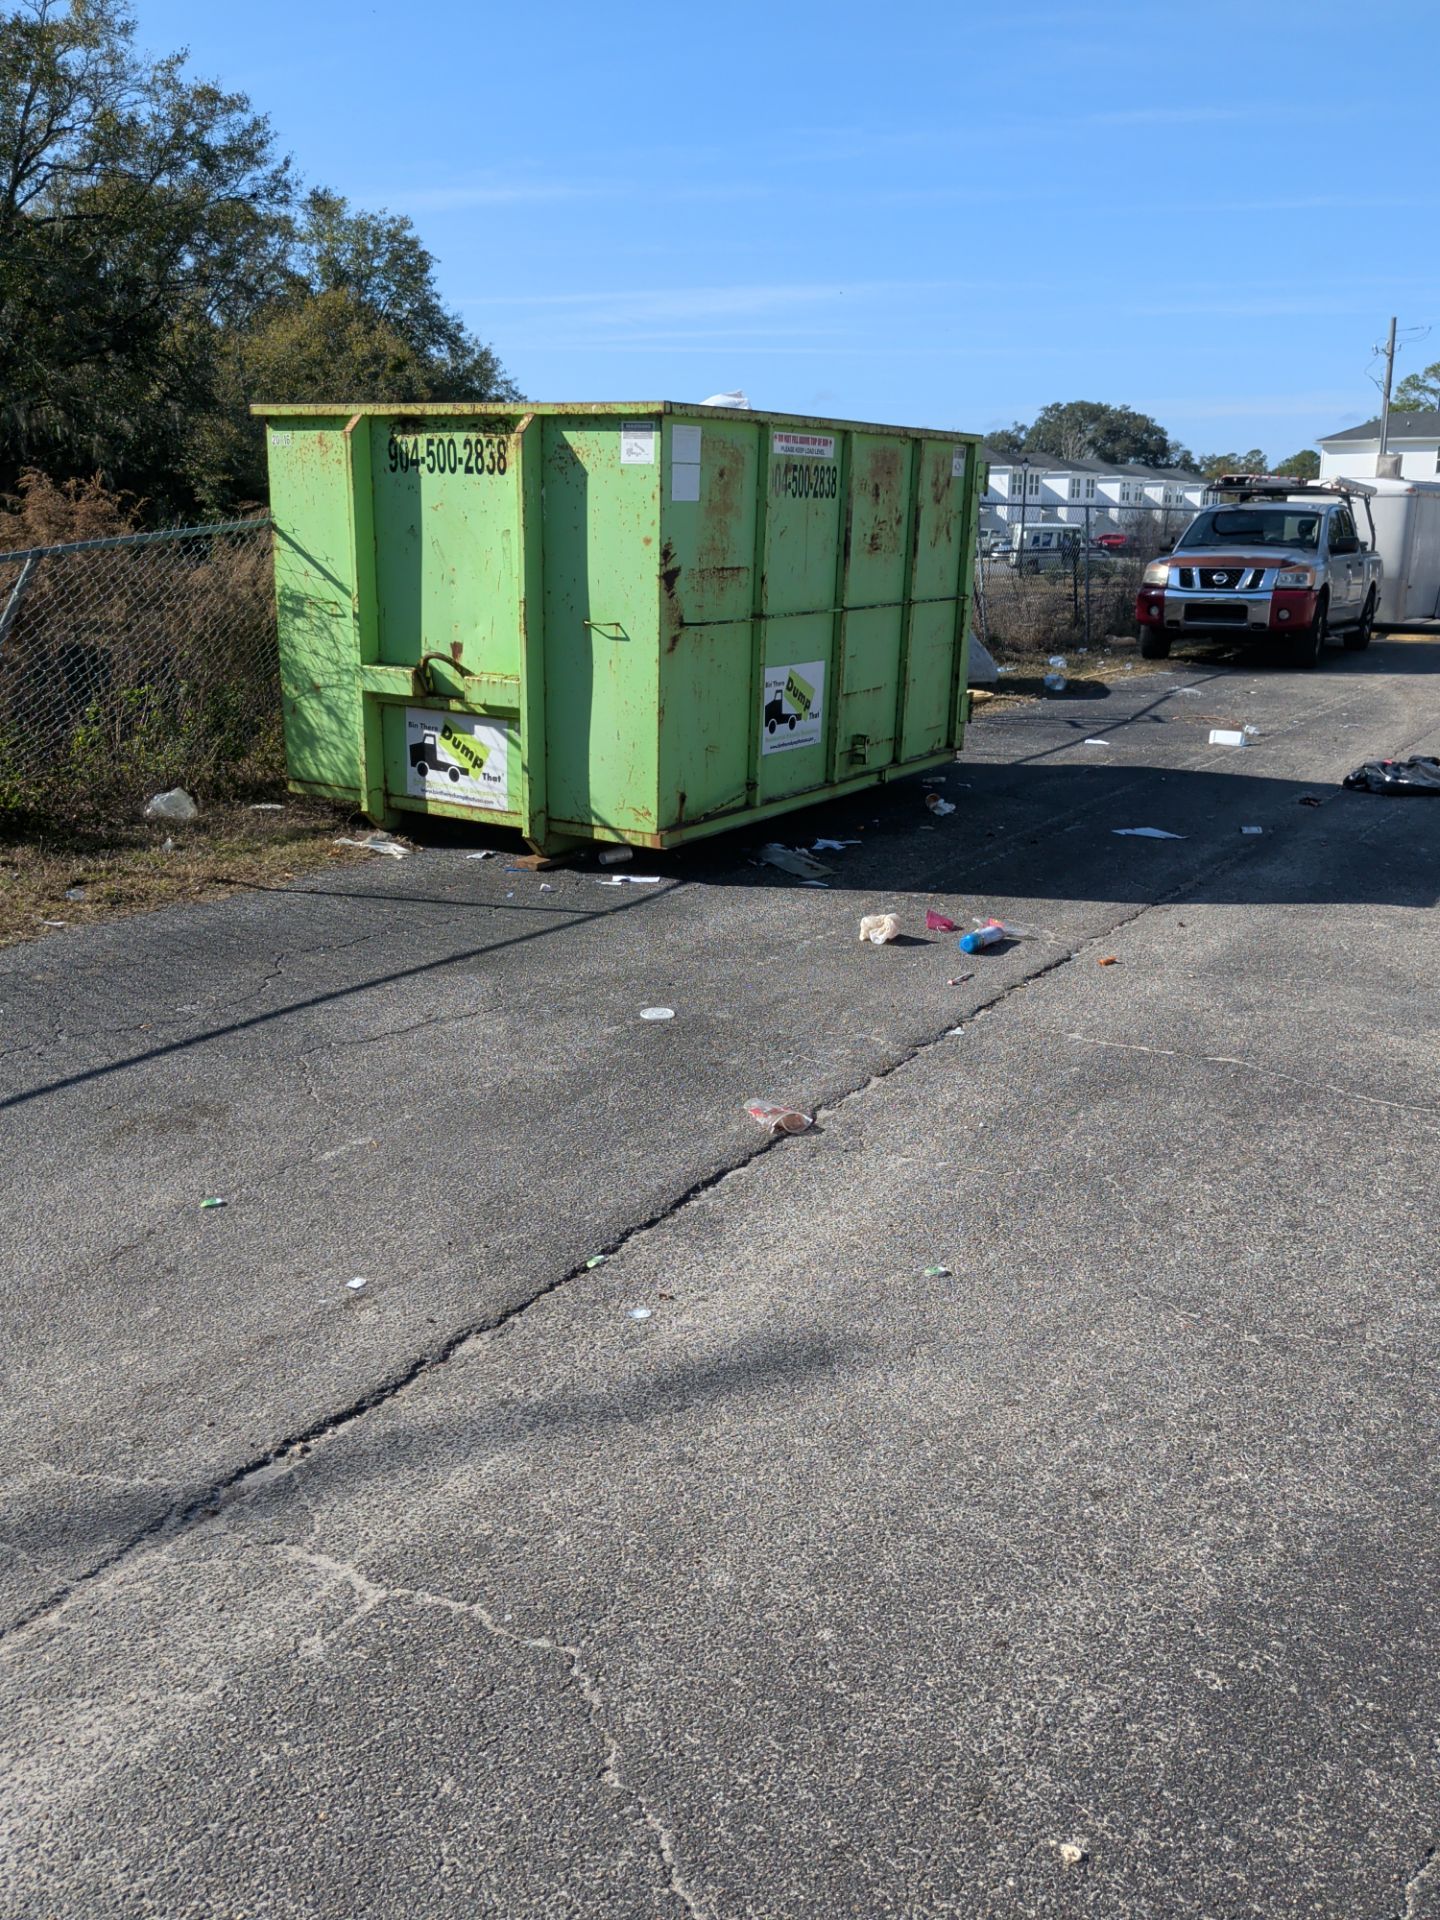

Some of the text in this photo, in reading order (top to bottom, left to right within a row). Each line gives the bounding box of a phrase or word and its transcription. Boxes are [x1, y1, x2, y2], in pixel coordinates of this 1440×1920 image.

[388, 438, 507, 475] 904-500-2838
[772, 464, 837, 499] 04-500-2838
[786, 676, 811, 712] Dump
[408, 721, 439, 732] Bin There
[809, 711, 820, 719] That
[441, 724, 484, 771] Dump
[482, 772, 502, 783] That
